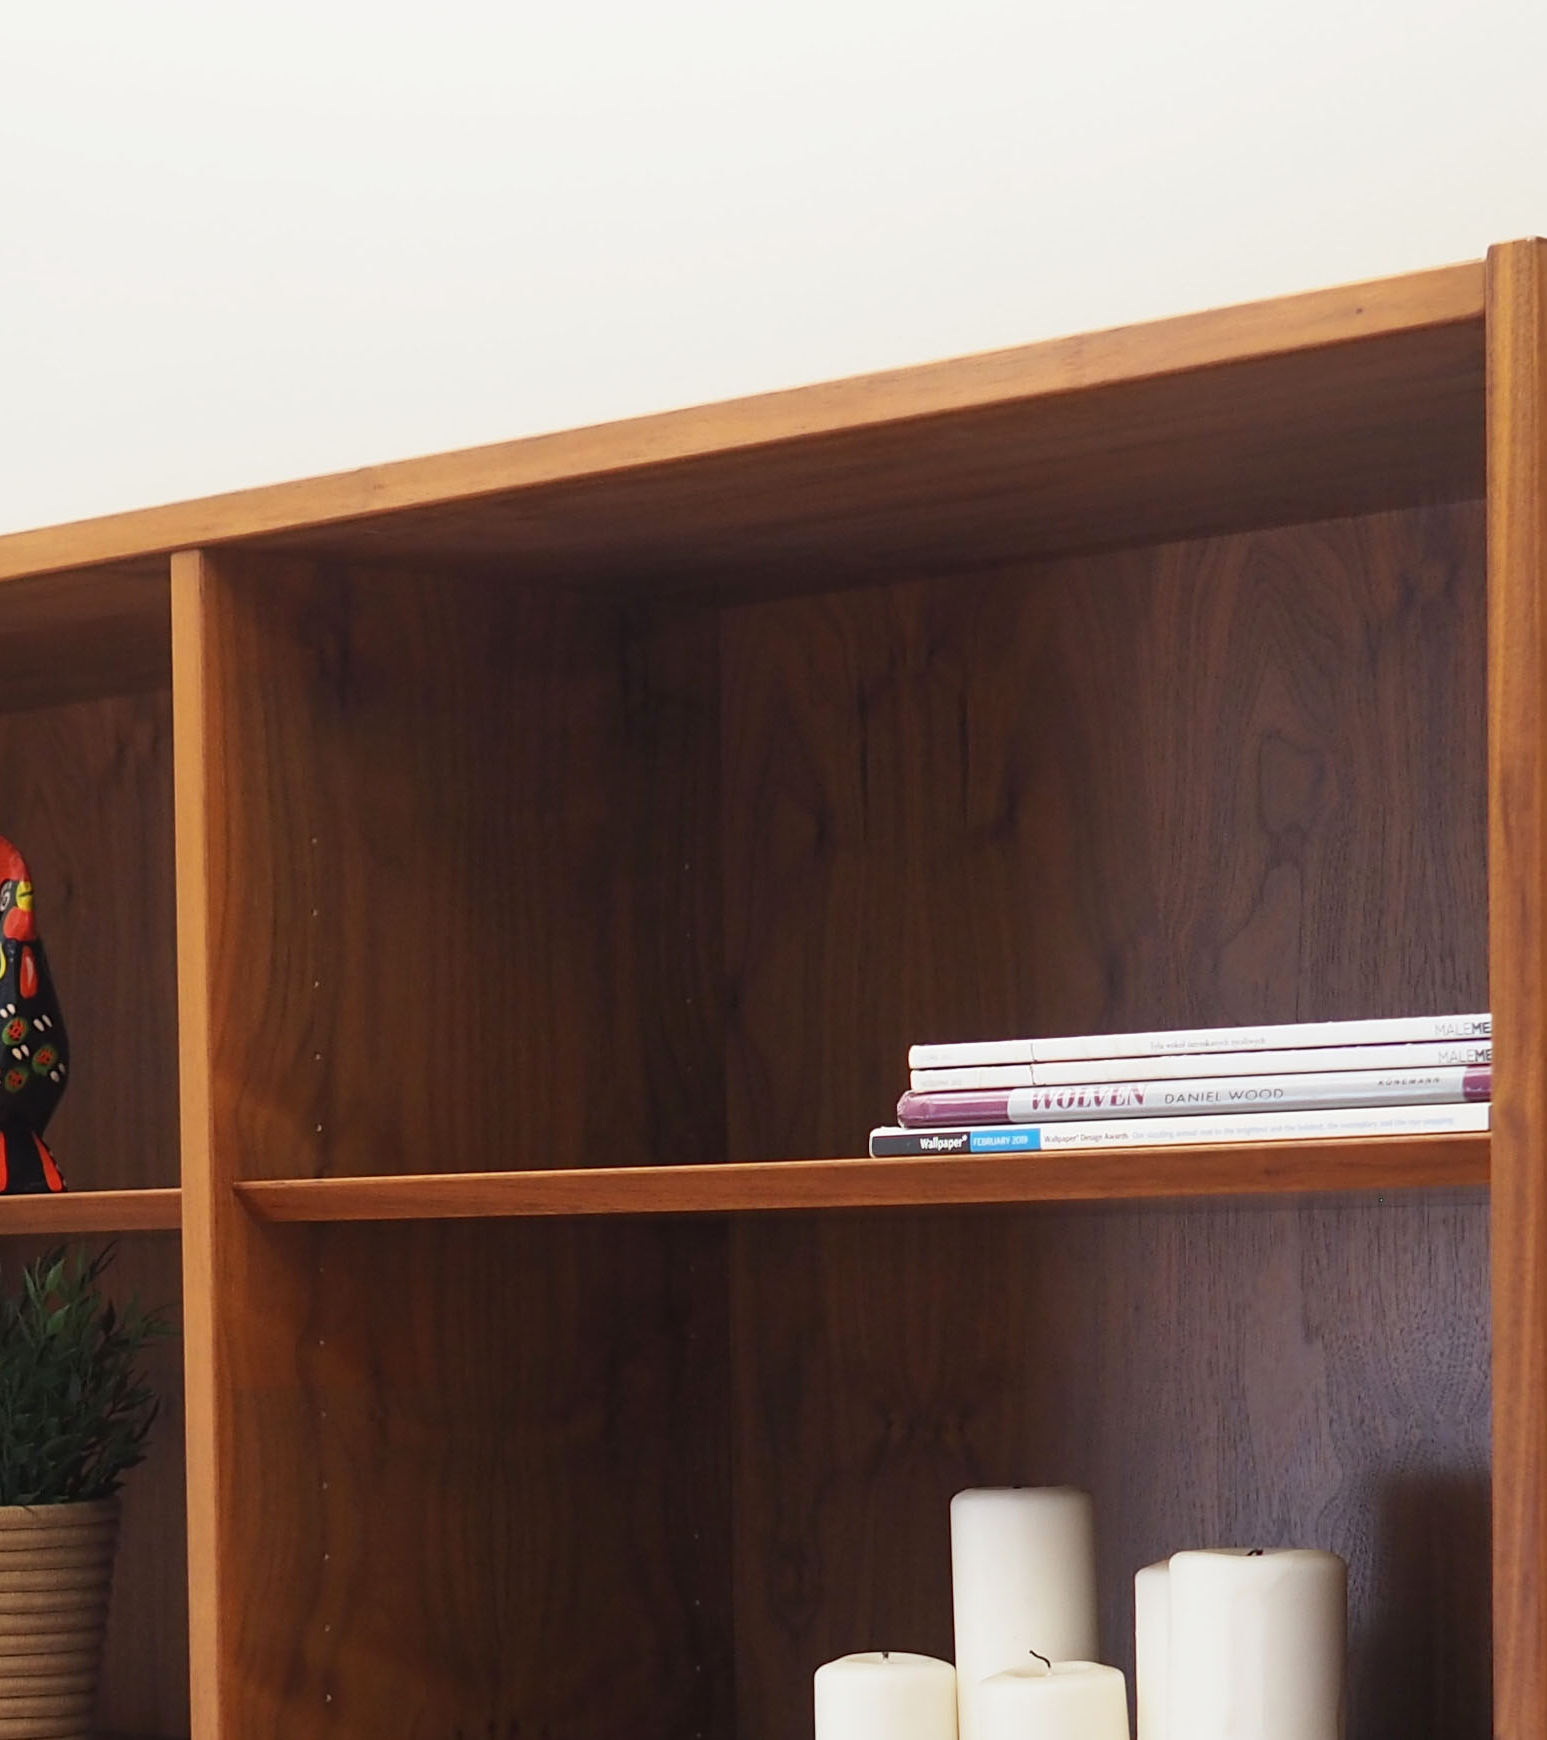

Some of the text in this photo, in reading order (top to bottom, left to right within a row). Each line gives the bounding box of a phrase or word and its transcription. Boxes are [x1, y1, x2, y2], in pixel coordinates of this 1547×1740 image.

[1031, 1084, 1148, 1111] WOLVEN
[1164, 1091, 1221, 1105] DANIEL
[1230, 1088, 1284, 1101] WOOD
[973, 1136, 1010, 1147] FEBRUARY
